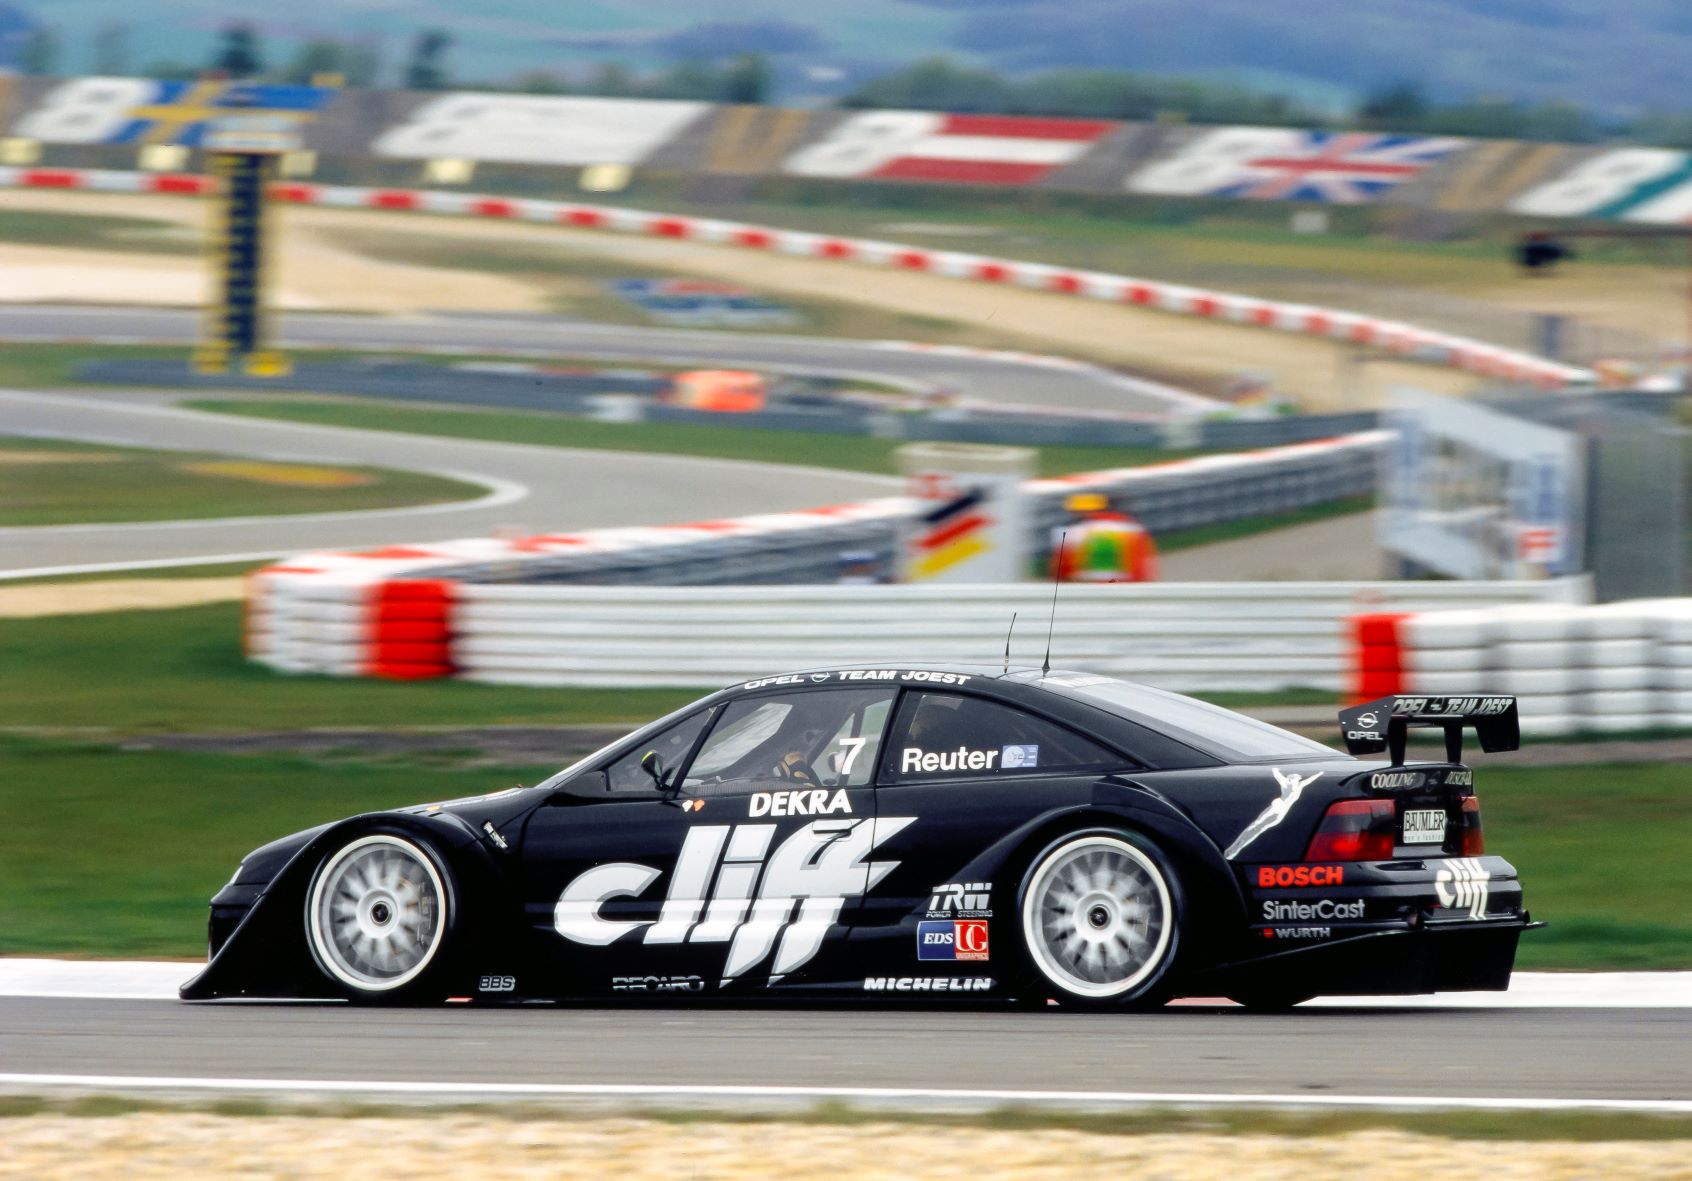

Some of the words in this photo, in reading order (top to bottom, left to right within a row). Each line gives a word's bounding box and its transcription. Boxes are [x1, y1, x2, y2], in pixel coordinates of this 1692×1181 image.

[744, 674, 804, 690] OPEL
[838, 670, 897, 681] TEAM
[901, 670, 971, 686] JOEST
[1442, 698, 1477, 715] TEAM
[1475, 698, 1514, 715] JOEST
[1347, 730, 1384, 741] OPEL
[839, 737, 866, 775] 7
[901, 746, 999, 773] Reuter
[1371, 772, 1417, 789] COOLING
[750, 788, 852, 818] DEKRA
[1258, 866, 1344, 887] BOSCH
[554, 816, 918, 988] cliff
[929, 882, 993, 911] TRW
[926, 910, 951, 918] POWER
[1263, 899, 1366, 920] SinterCast
[923, 932, 954, 945] EDS
[479, 975, 516, 992] BBS
[612, 975, 704, 992] RECARO
[863, 977, 992, 991] MICHELIN
